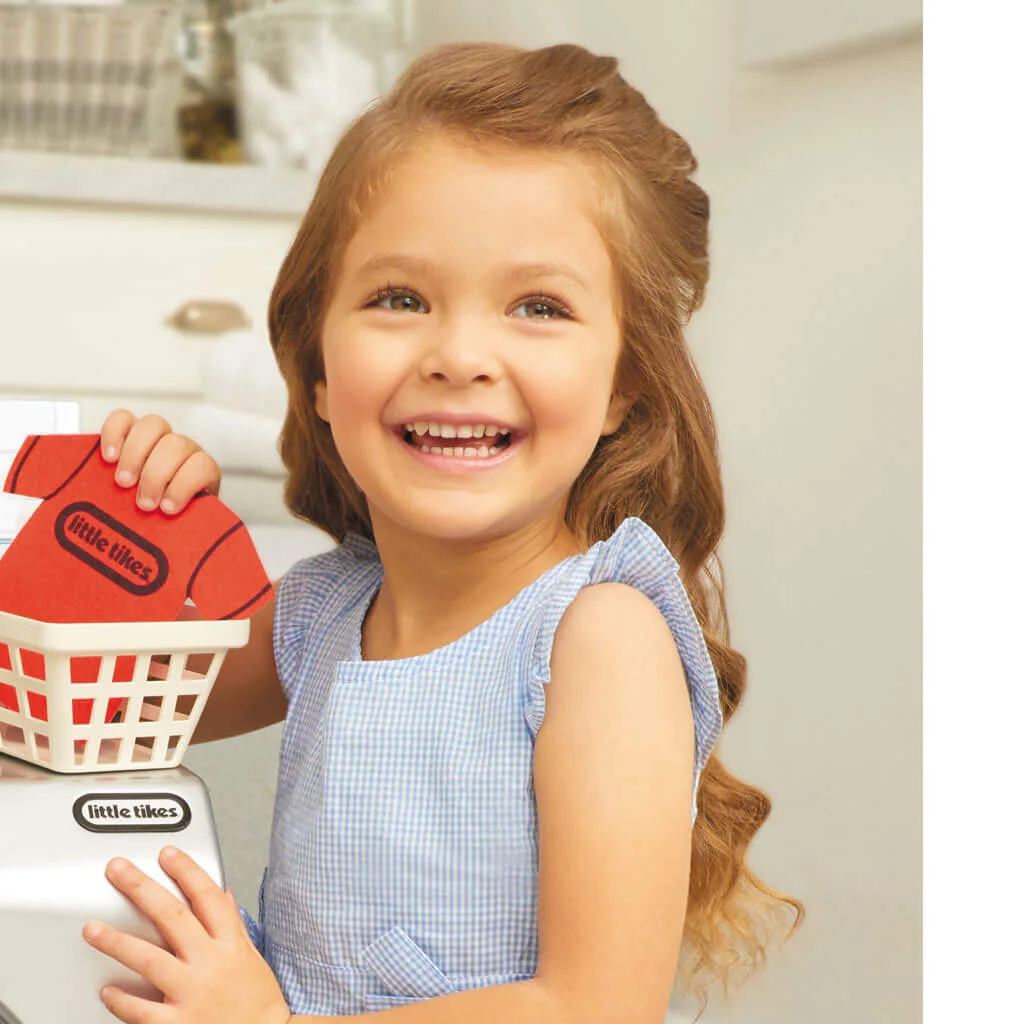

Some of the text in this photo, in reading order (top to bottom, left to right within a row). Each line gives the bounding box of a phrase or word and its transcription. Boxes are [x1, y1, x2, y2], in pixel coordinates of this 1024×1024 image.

[67, 514, 152, 581] little tikes
[87, 804, 178, 819] little tikes
